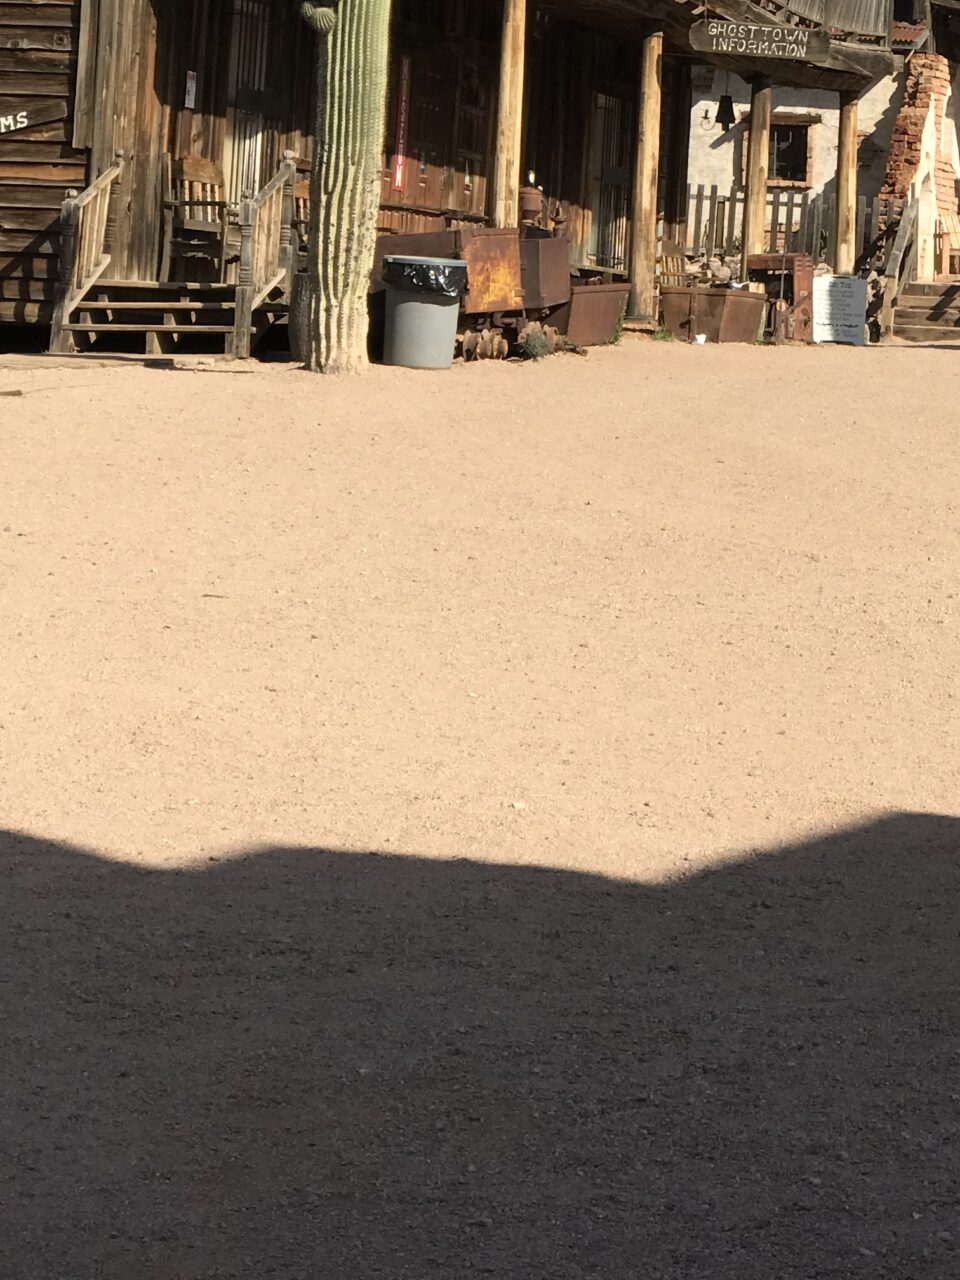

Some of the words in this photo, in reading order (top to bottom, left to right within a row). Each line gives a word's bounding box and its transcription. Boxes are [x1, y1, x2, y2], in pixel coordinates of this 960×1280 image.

[708, 22, 759, 38] GHOST
[761, 26, 809, 42] TOWN
[712, 37, 807, 58] INFORMATION
